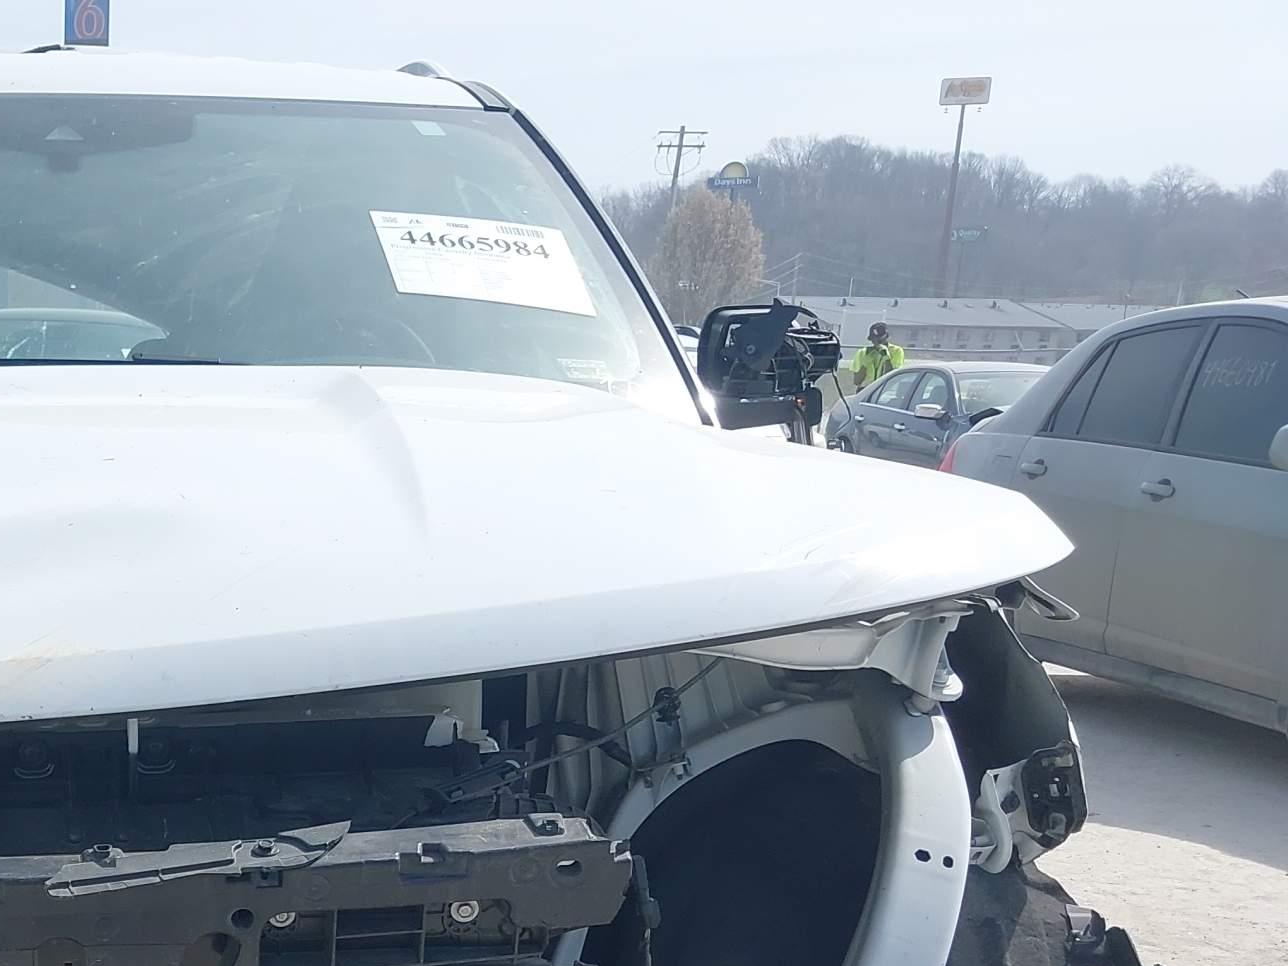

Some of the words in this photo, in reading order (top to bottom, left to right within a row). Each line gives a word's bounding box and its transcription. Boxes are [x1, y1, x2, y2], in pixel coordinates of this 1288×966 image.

[74, 0, 105, 39] 6
[714, 178, 736, 189] Days
[737, 177, 752, 185] Inn
[399, 229, 550, 260] 44665984
